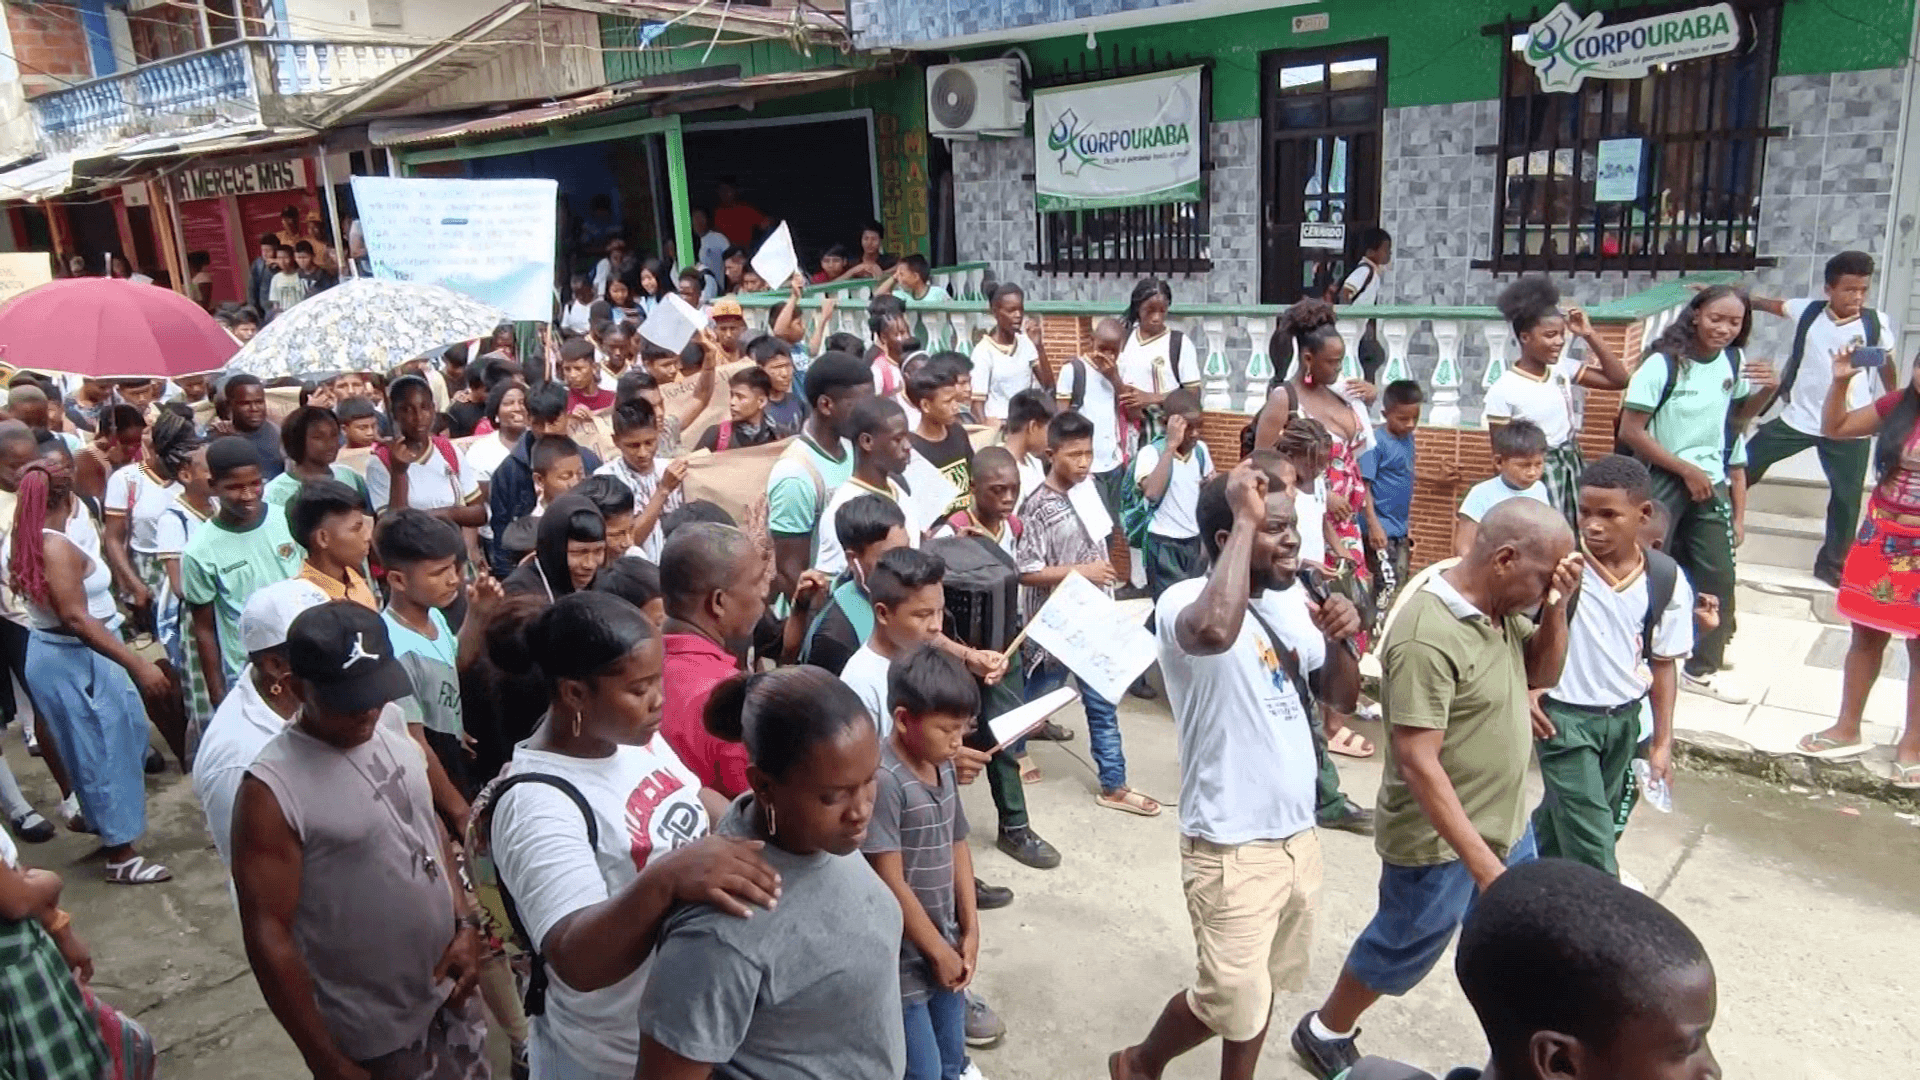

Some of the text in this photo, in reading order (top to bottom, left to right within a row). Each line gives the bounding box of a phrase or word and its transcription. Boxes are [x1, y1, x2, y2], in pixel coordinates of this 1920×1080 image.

[1574, 12, 1730, 60] CORPOURABA
[1079, 122, 1189, 155] CORPOURABA
[192, 164, 254, 198] MERECE
